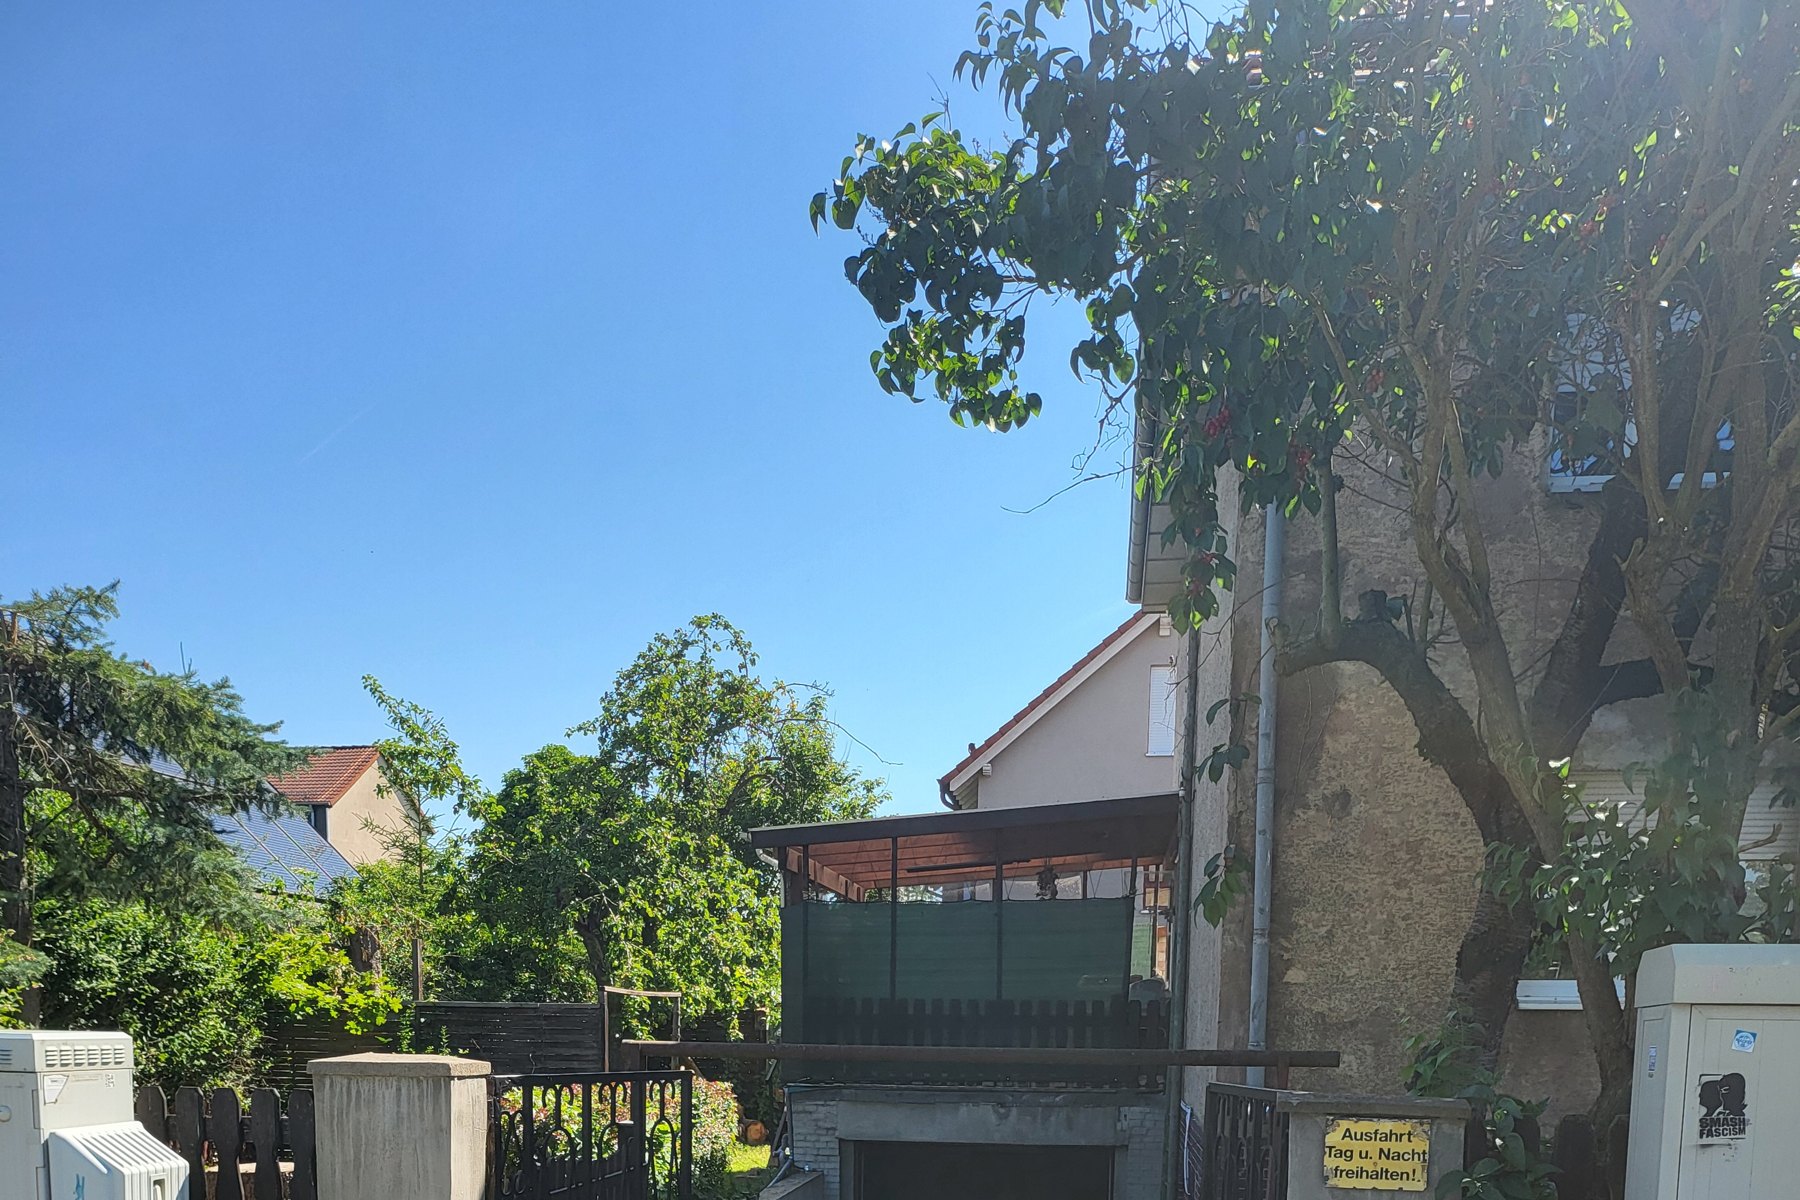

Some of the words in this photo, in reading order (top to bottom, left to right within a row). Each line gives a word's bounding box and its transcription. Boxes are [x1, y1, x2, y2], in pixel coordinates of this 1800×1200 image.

[1699, 1117, 1745, 1128] SMASH
[1341, 1128, 1413, 1143] Ausfahrt
[1699, 1127, 1745, 1138] FASCISM
[1326, 1145, 1353, 1162] Tag
[1358, 1149, 1373, 1160] u.
[1378, 1147, 1428, 1162] Nacht
[1333, 1166, 1416, 1181] freihalten!
